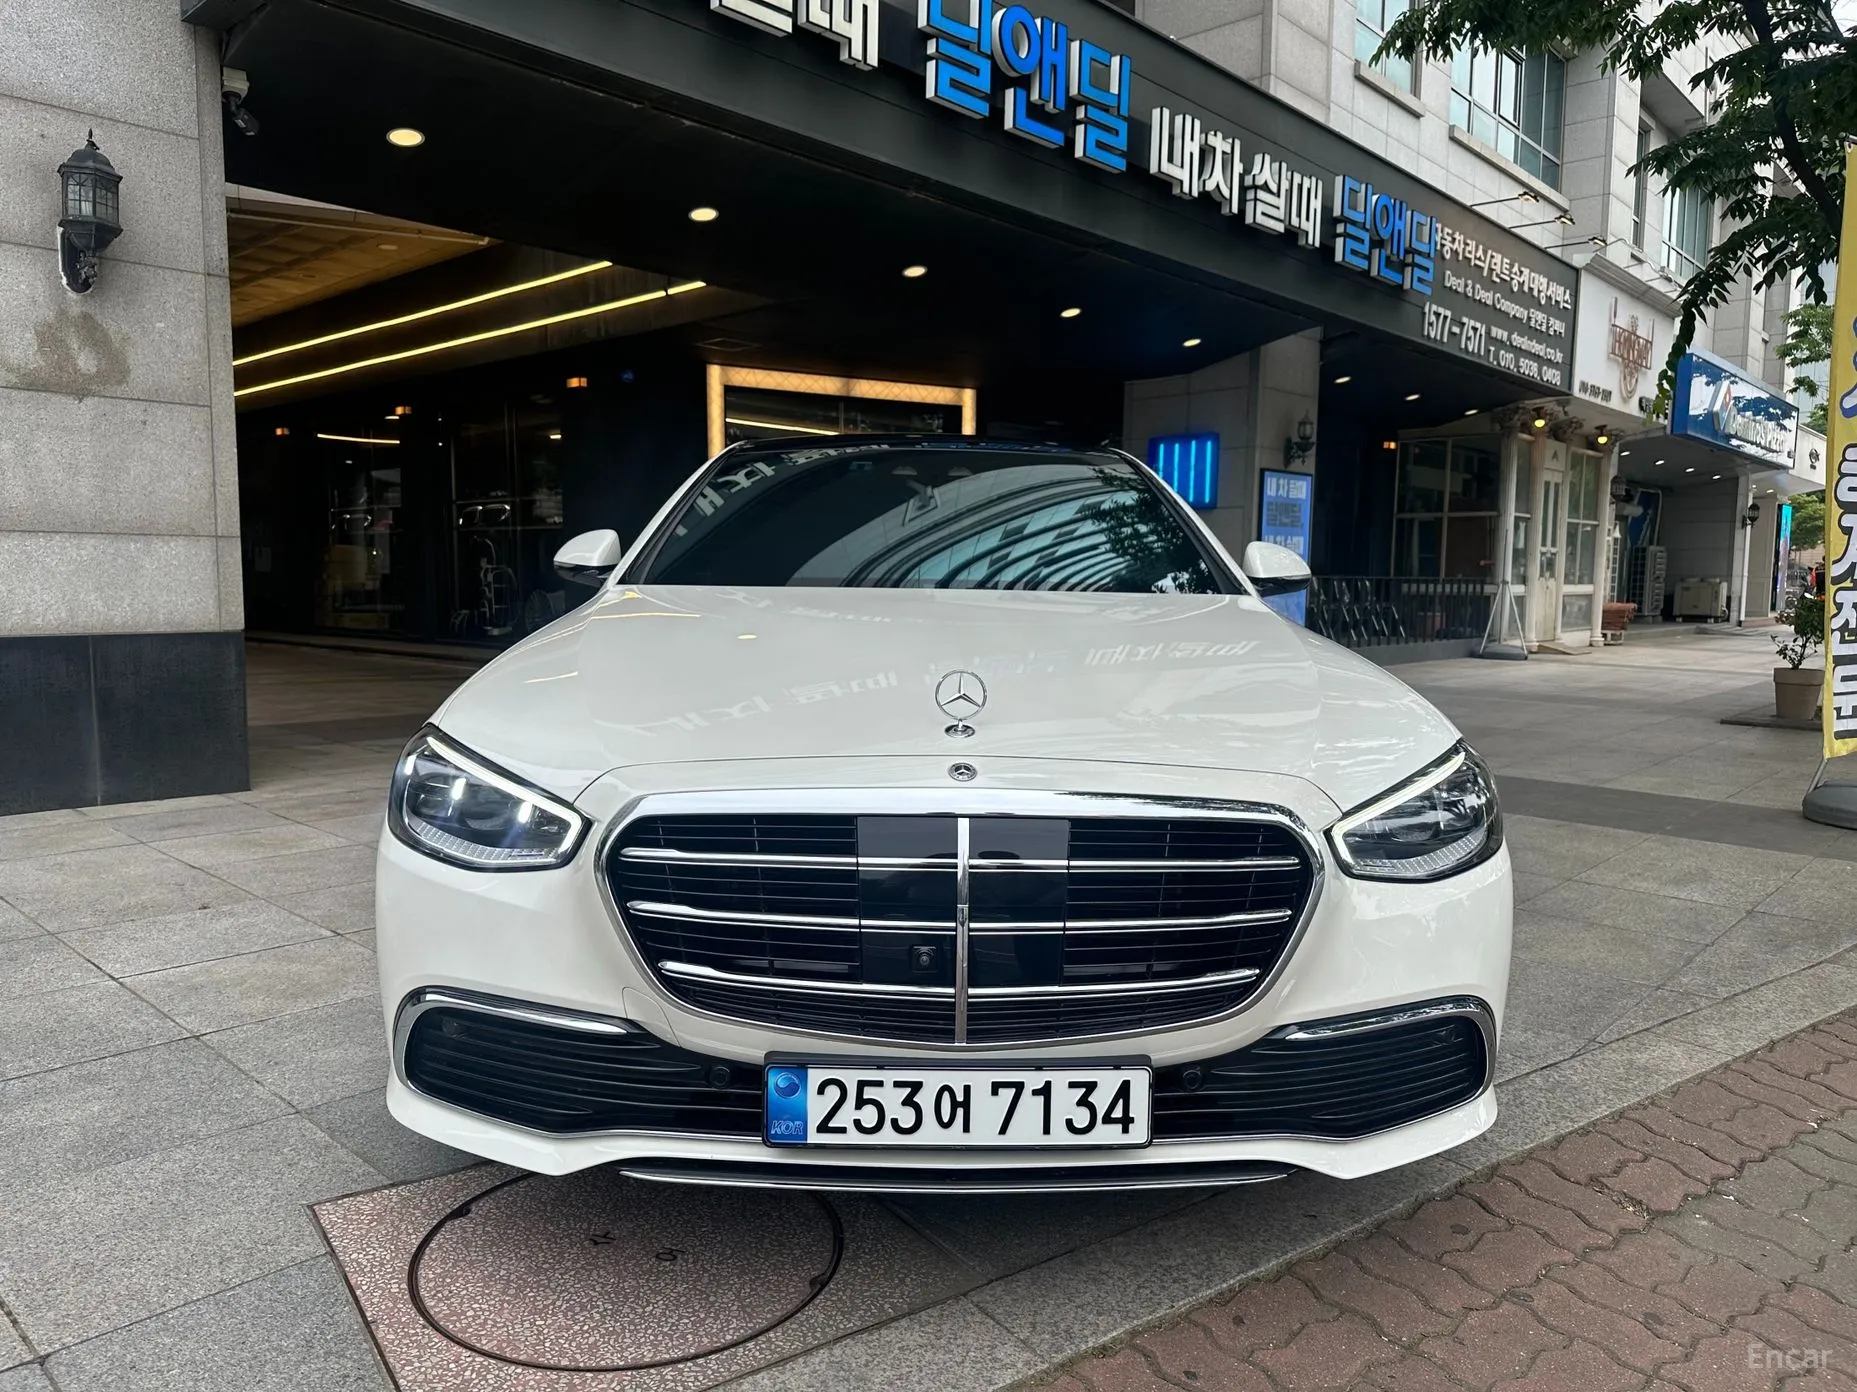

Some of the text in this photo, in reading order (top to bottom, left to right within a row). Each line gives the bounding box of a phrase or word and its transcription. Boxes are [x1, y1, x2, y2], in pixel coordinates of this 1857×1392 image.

[918, 0, 1132, 174] 딜앤딜
[1333, 174, 1438, 296] 딜앤딜
[1444, 271, 1464, 293] Deal
[1466, 279, 1473, 297] &
[1474, 284, 1493, 306] Deal
[1494, 293, 1528, 323] Company
[1423, 301, 1486, 356] 1577-7571
[770, 1120, 804, 1135] KOR
[815, 1077, 1135, 1136] 253어 7134
